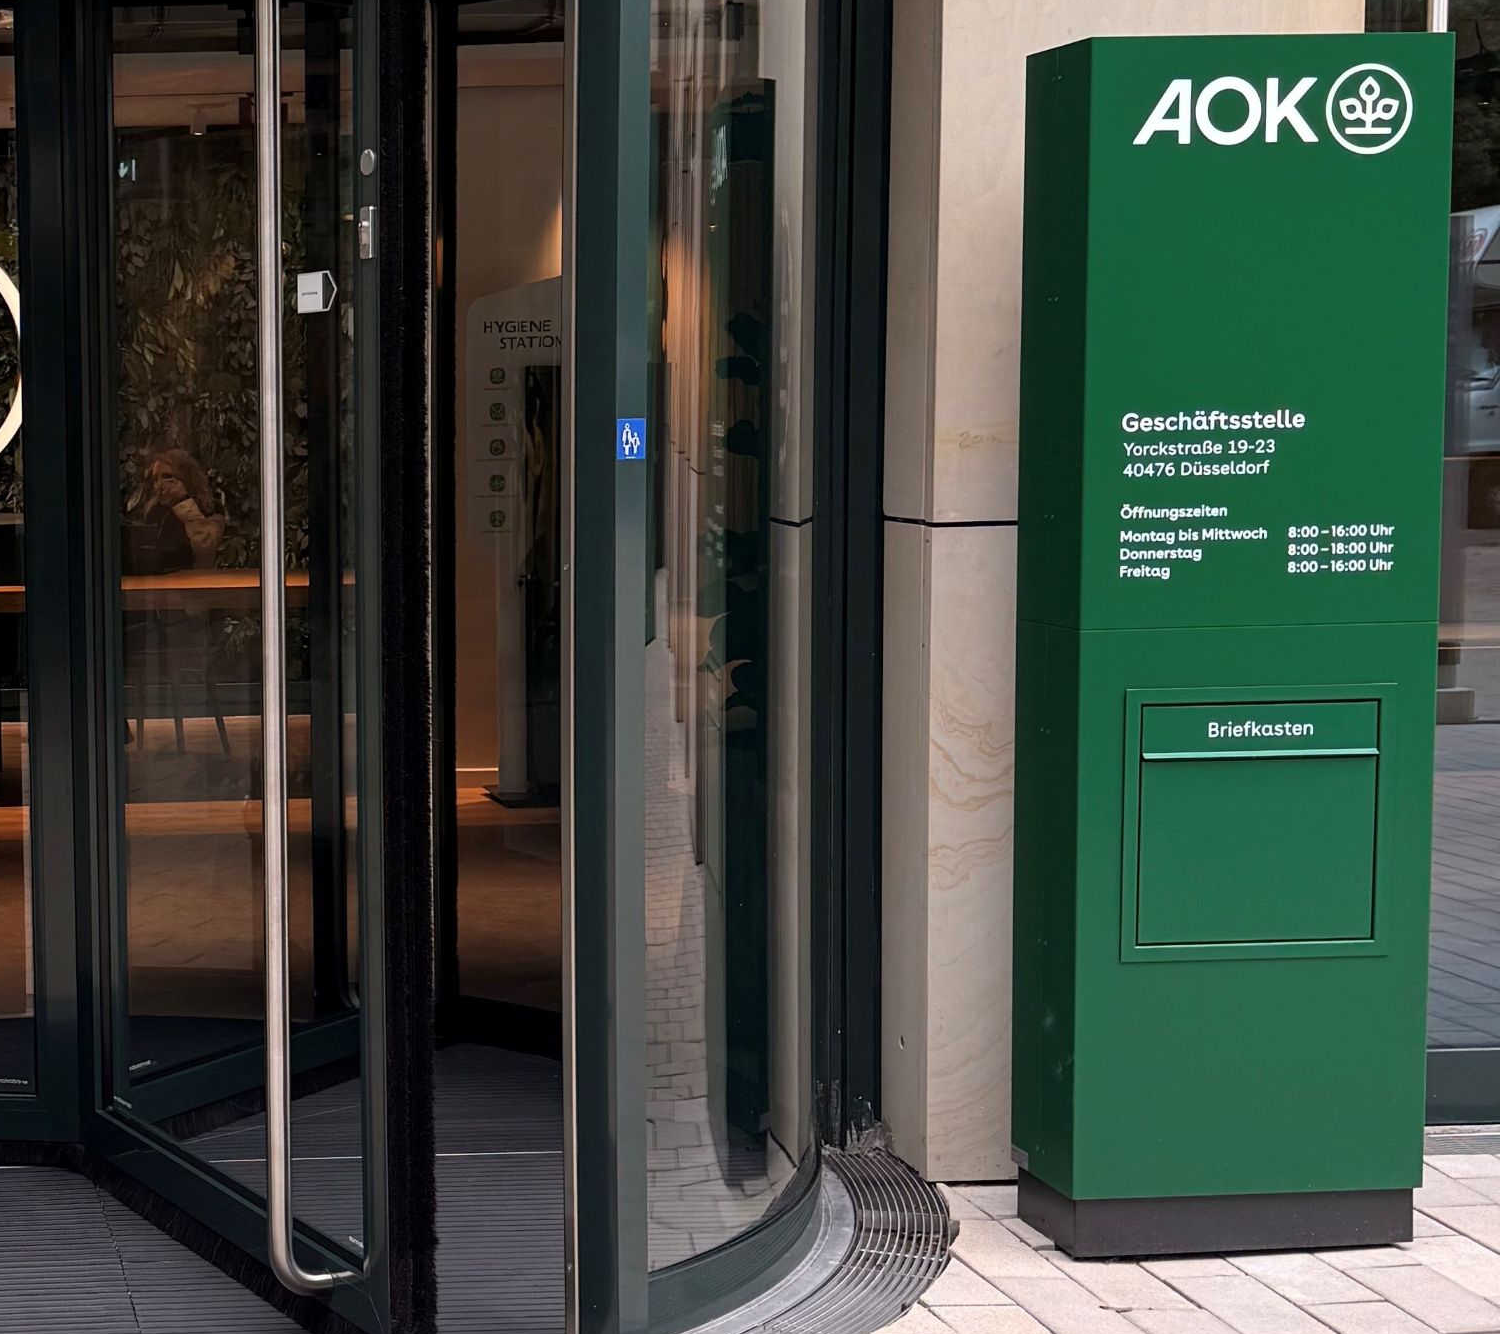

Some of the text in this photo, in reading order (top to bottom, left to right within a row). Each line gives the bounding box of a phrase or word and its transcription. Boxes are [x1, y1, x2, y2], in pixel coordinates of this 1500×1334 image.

[1132, 75, 1320, 146] AOK
[483, 319, 553, 334] HYGIENE
[1121, 409, 1306, 433] Geschäftsstelle
[1123, 438, 1276, 457] Yorckstraße 19-23
[1122, 459, 1270, 478] 40476 Düsseldorf
[1119, 503, 1228, 522] Öffnungszeiten
[1119, 530, 1176, 545] Montag
[1178, 528, 1199, 542] bis
[1201, 526, 1268, 541] Mittwoch
[1287, 525, 1319, 539] 8:00
[1330, 524, 1368, 538] 16:00
[1369, 523, 1395, 537] Uhr
[1119, 547, 1203, 562] Donnerstag
[1287, 543, 1319, 556] 8:00
[1330, 541, 1367, 555] 18:00
[1369, 541, 1395, 554] Uhr
[1119, 564, 1171, 580] Freitag
[1287, 560, 1319, 574] 8:00
[1330, 559, 1367, 572] 16:00
[1368, 558, 1394, 571] Uhr
[1207, 720, 1314, 738] Briefkasten
